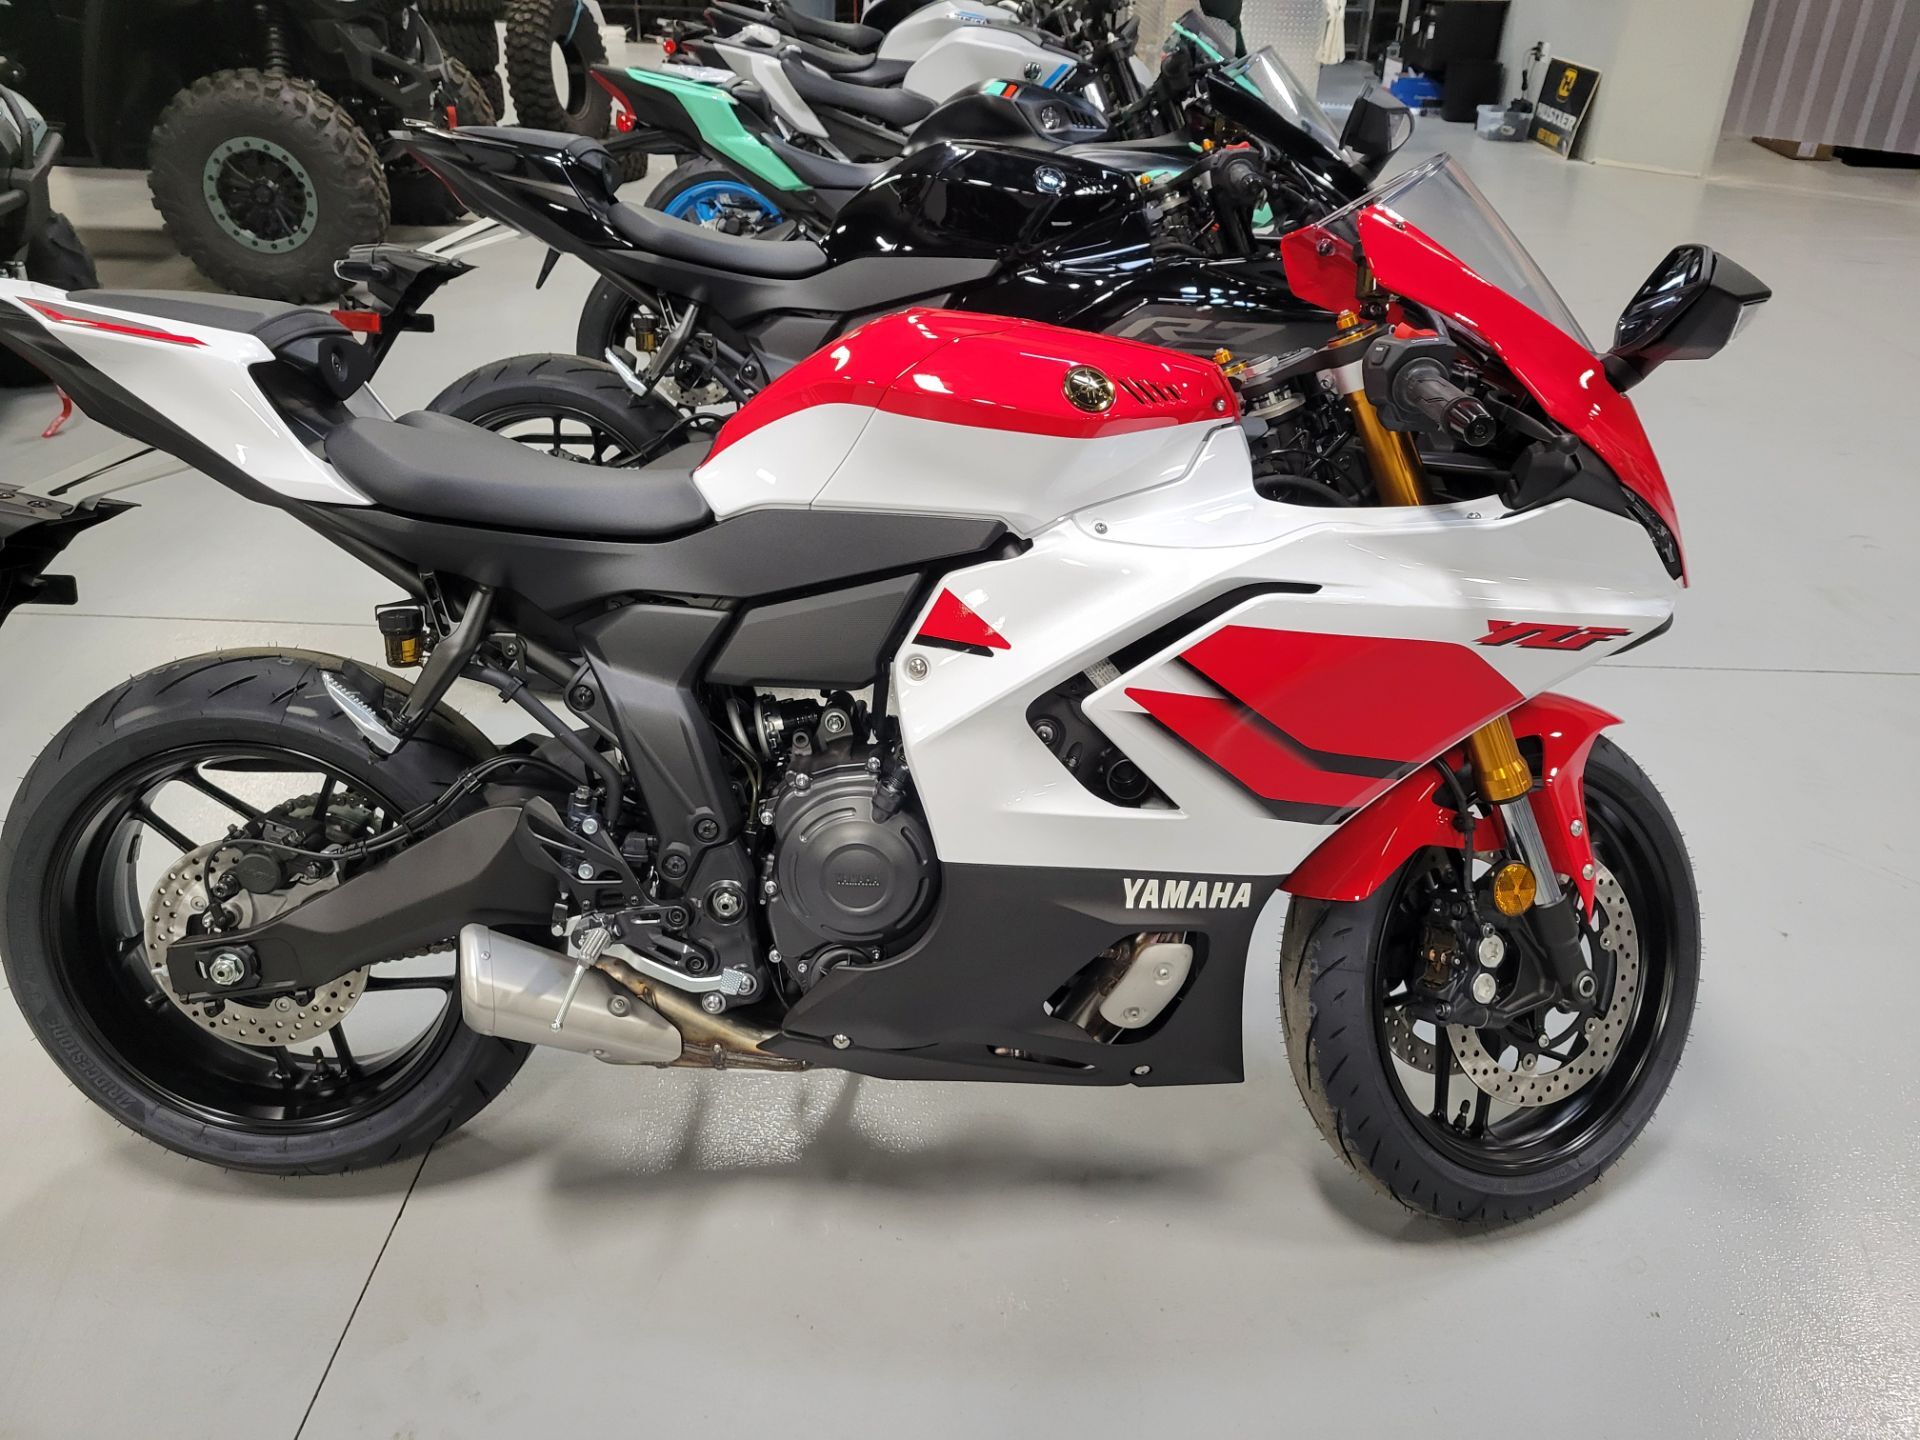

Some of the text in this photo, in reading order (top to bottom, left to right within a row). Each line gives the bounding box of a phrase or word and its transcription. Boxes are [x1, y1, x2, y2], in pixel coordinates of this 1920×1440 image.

[1117, 316, 1287, 345] R7
[1471, 619, 1635, 651] YZF
[1123, 878, 1252, 909] YAMAHA
